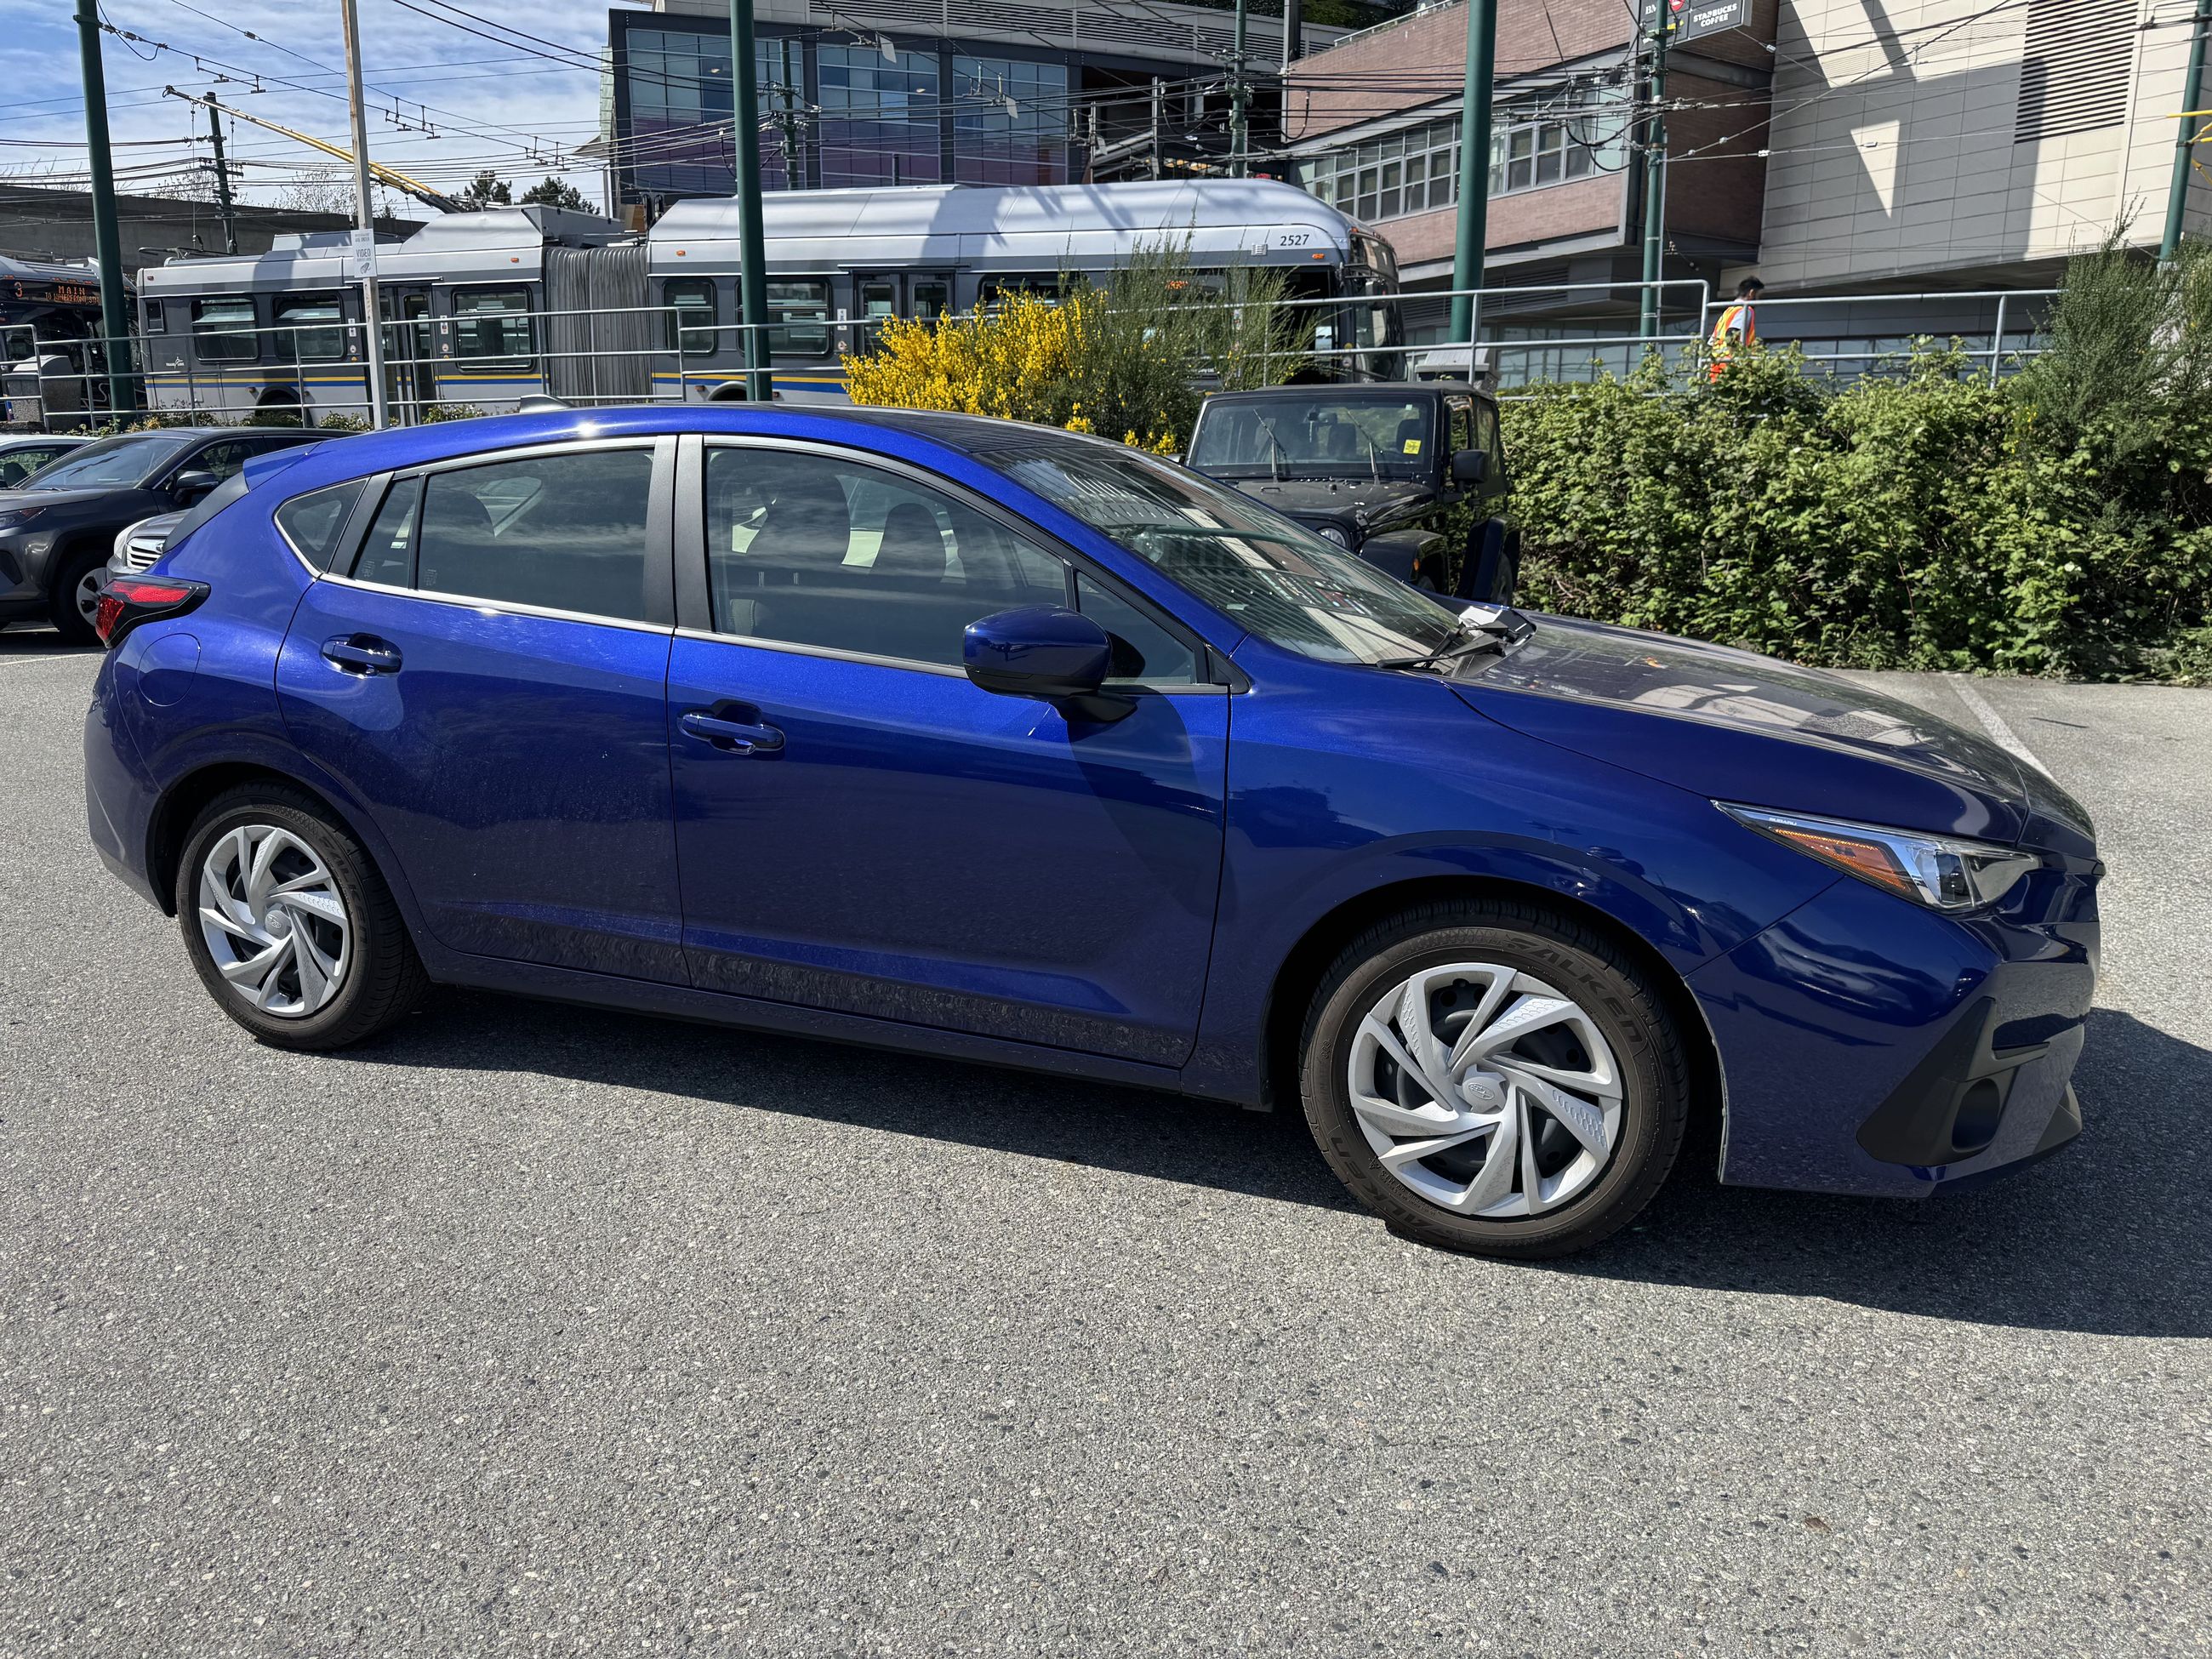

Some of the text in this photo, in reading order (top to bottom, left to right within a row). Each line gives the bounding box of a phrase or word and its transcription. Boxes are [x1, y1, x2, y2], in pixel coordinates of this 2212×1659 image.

[1693, 3, 1737, 22] STARBUCKS
[1700, 14, 1729, 27] COFFEE
[1280, 233, 1310, 247] 2527
[356, 248, 371, 258] VIDEO
[14, 282, 23, 298] 3
[58, 285, 86, 295] MAIN
[1504, 937, 1644, 1043] FALKEN
